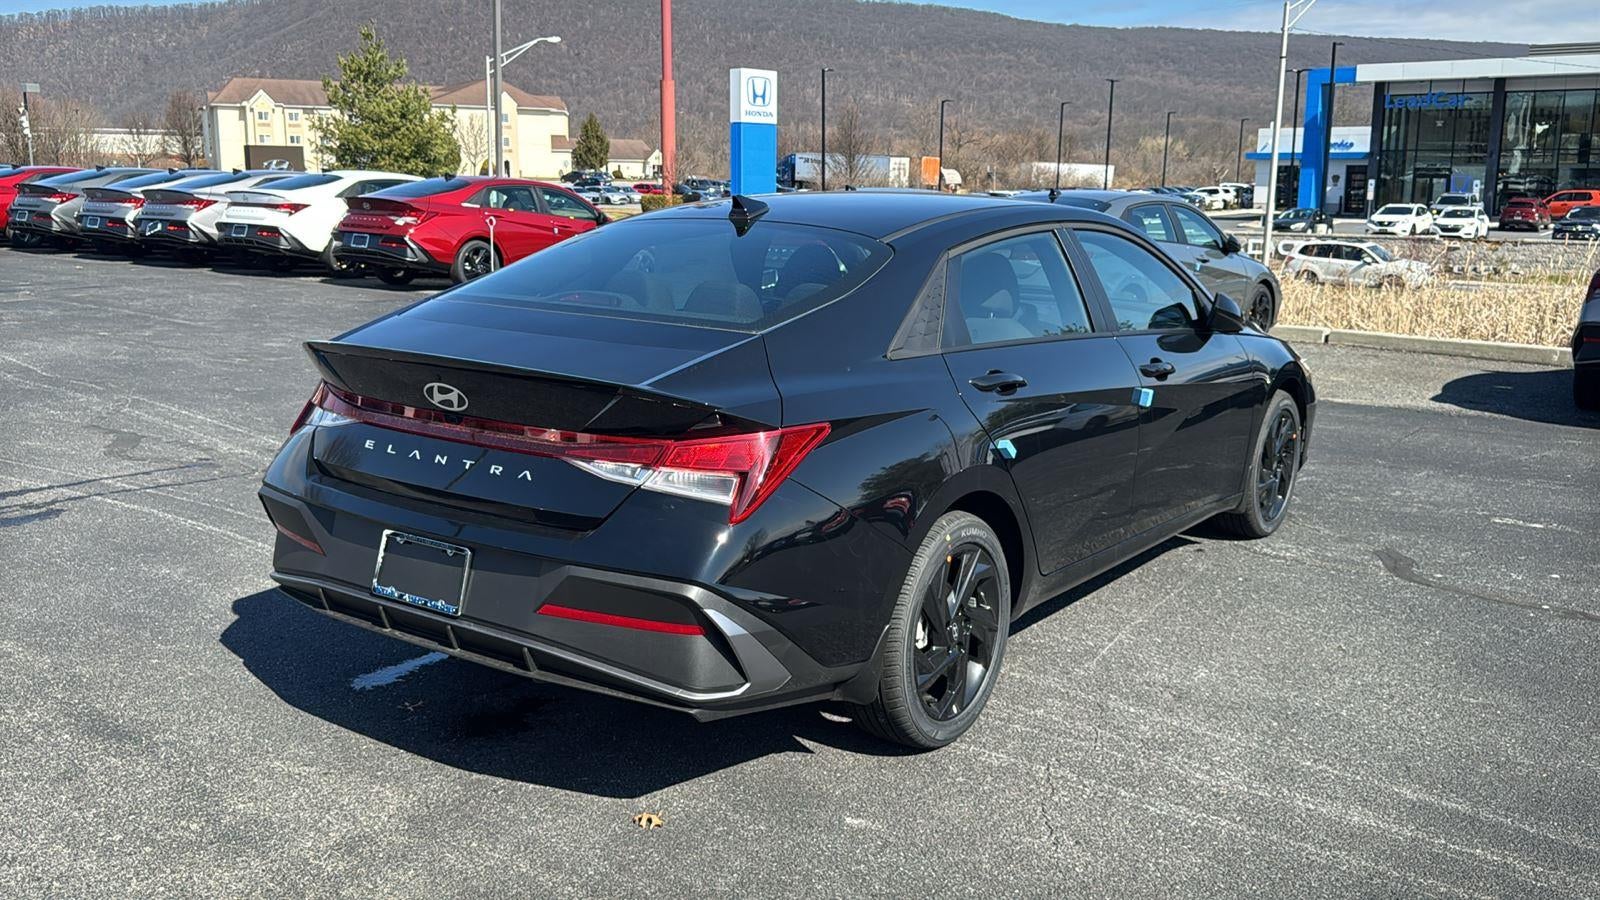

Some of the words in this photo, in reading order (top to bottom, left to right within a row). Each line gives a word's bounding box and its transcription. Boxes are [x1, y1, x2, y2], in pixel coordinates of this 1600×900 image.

[1385, 90, 1471, 109] LeadCar
[745, 110, 773, 118] HONDA
[364, 439, 533, 481] ELANTRA
[961, 527, 988, 538] KUMHO
